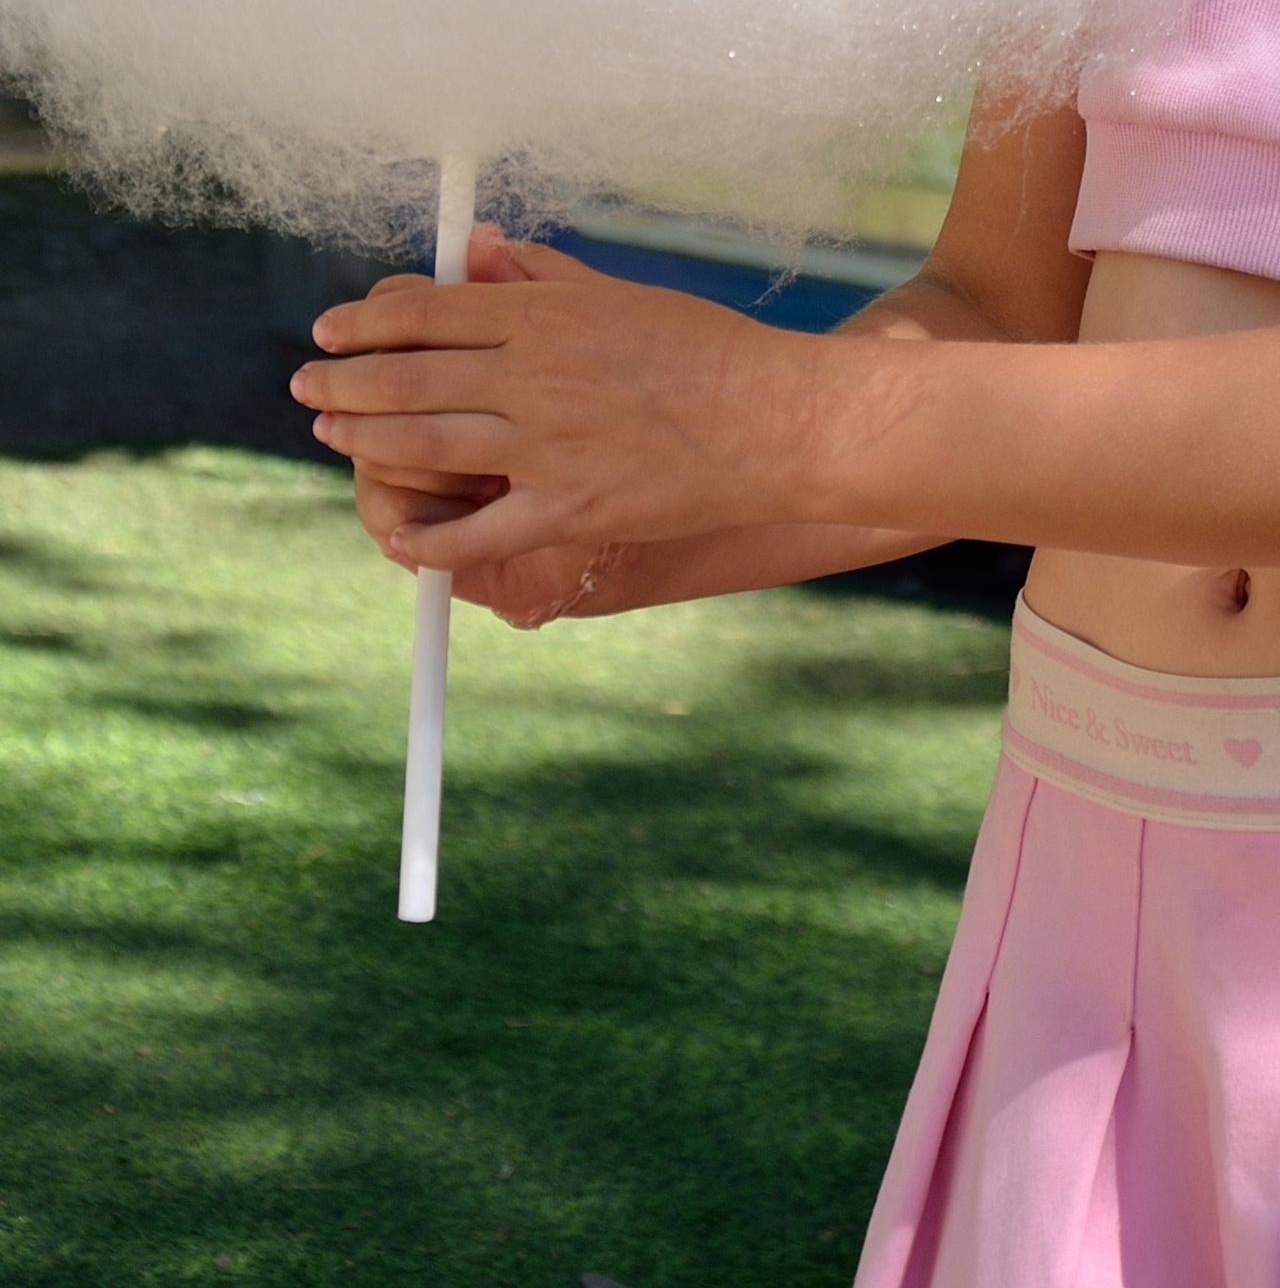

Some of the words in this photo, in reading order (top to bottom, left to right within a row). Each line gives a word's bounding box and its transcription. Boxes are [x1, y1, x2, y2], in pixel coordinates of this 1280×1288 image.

[1028, 675, 1080, 731] Nice
[1086, 707, 1113, 744] &
[1115, 717, 1199, 766] Sweet
